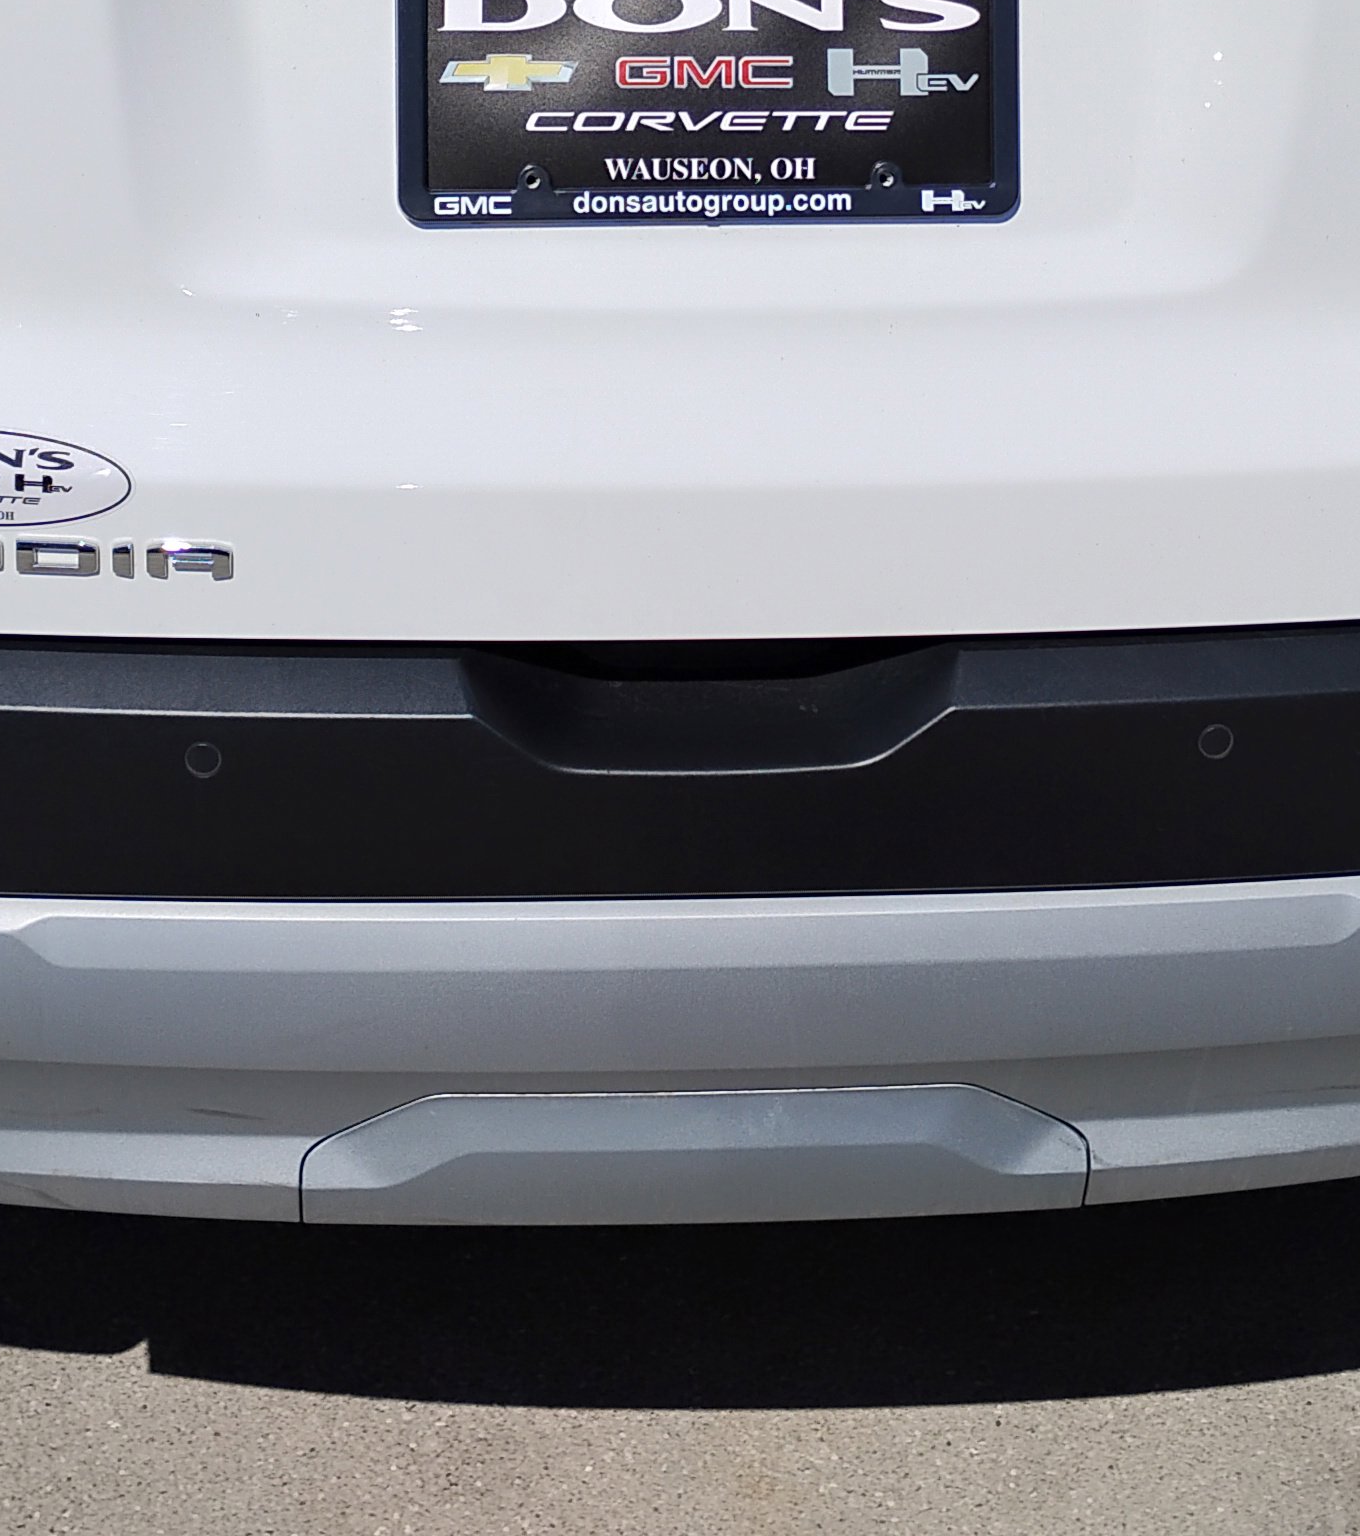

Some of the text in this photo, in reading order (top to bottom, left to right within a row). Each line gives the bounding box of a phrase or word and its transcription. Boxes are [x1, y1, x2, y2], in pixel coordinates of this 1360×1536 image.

[614, 55, 794, 89] GMC
[525, 110, 895, 132] CORVETTE
[604, 157, 817, 183] WAUSEON, OH
[433, 195, 513, 216] GMC
[572, 190, 853, 218] donsautogroup.com
